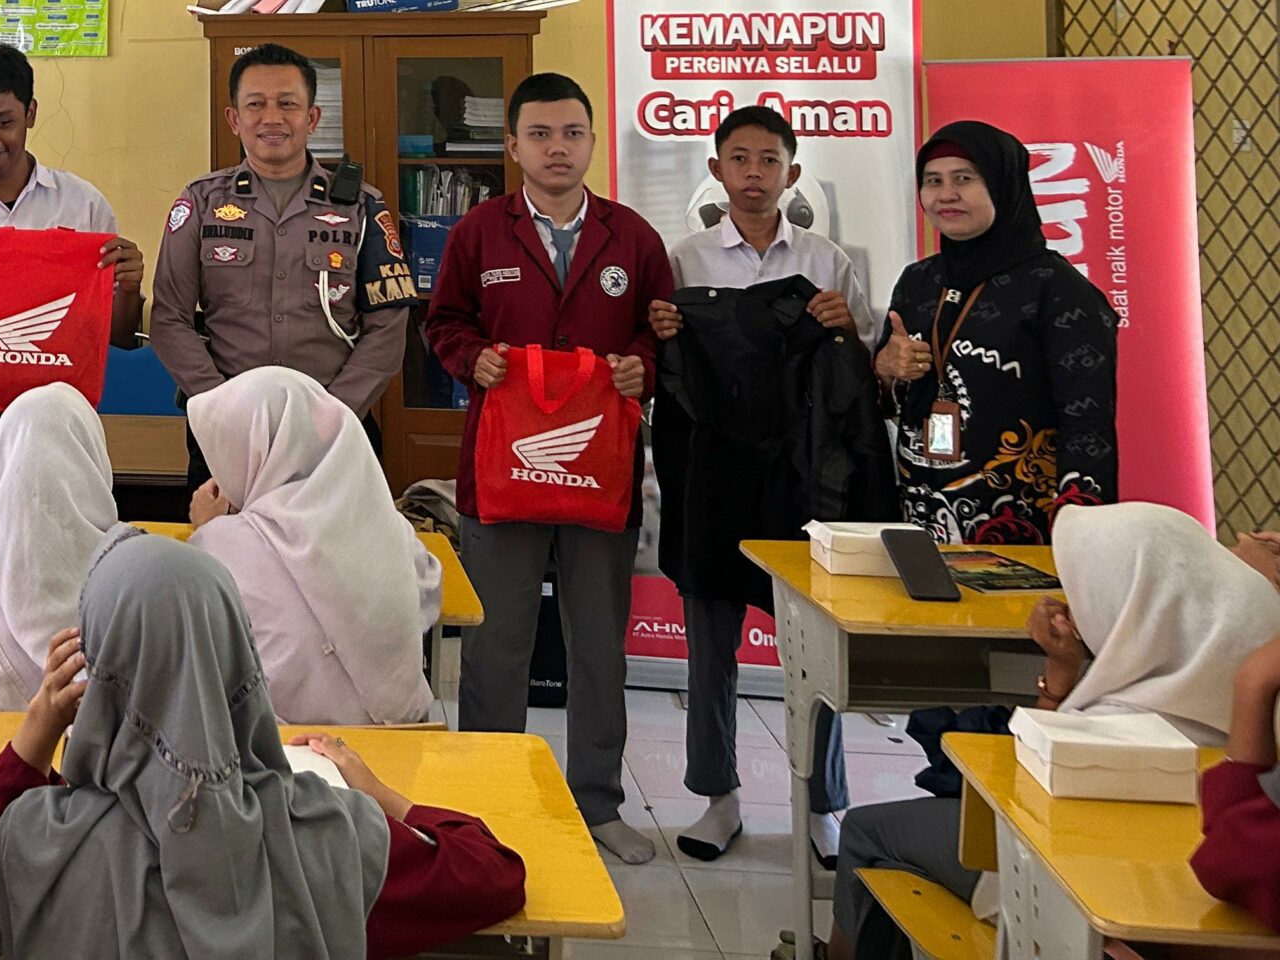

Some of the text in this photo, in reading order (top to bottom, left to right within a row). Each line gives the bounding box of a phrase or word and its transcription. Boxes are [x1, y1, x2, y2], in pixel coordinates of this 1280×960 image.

[642, 14, 882, 47] KEMANAPUN
[666, 56, 861, 74] PERGINYA SELALU
[1104, 186, 1125, 240] motor
[1106, 246, 1127, 283] naik
[510, 467, 601, 488] HONDA
